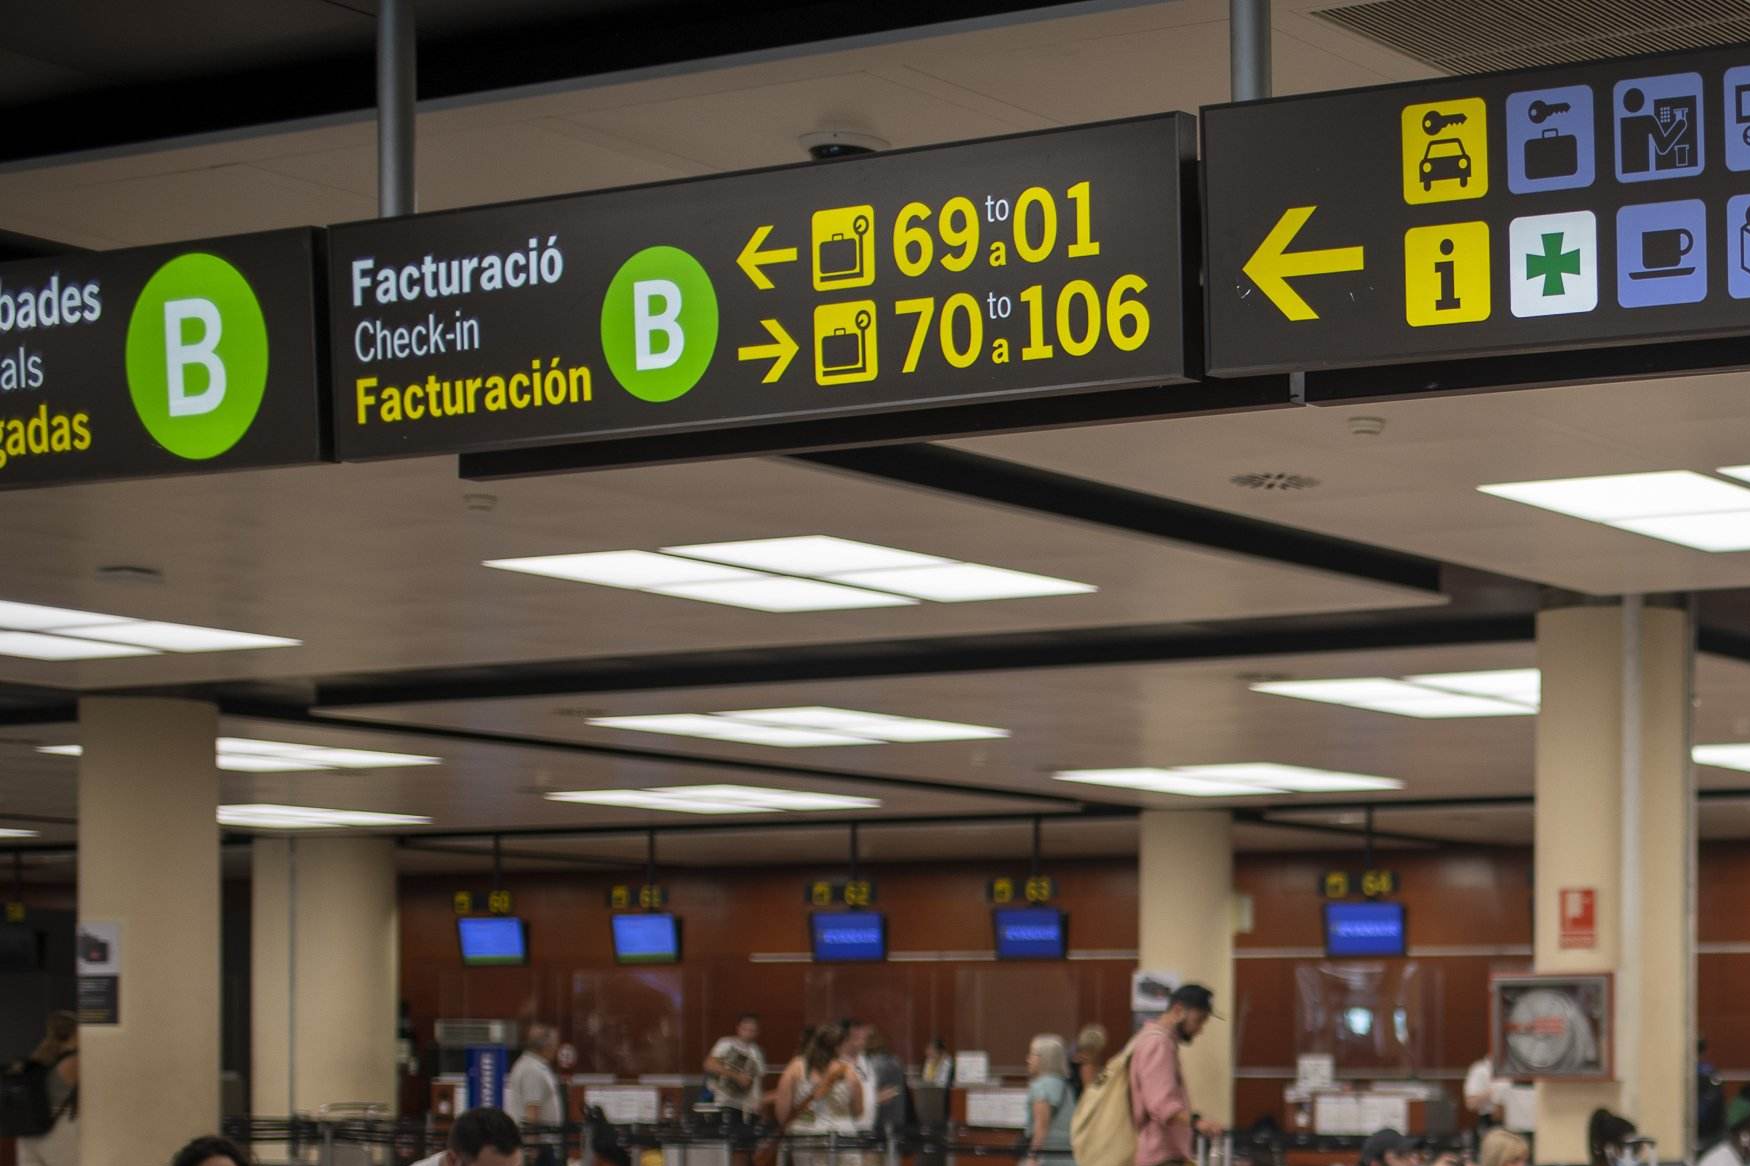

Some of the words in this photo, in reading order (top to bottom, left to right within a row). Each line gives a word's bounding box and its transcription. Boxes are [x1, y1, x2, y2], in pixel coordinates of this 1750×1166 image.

[893, 196, 980, 277] 69
[985, 193, 1010, 223] to
[1012, 181, 1100, 264] 01
[351, 236, 563, 306] Facturació
[989, 240, 1007, 267] a
[355, 314, 480, 362] Check-in
[633, 279, 685, 372] B
[895, 292, 984, 374] 70
[987, 291, 1012, 320] to
[1020, 274, 1150, 361] 106
[164, 298, 227, 417] B
[991, 338, 1010, 364] a
[356, 356, 592, 424] Facturación
[0, 404, 92, 468] adas
